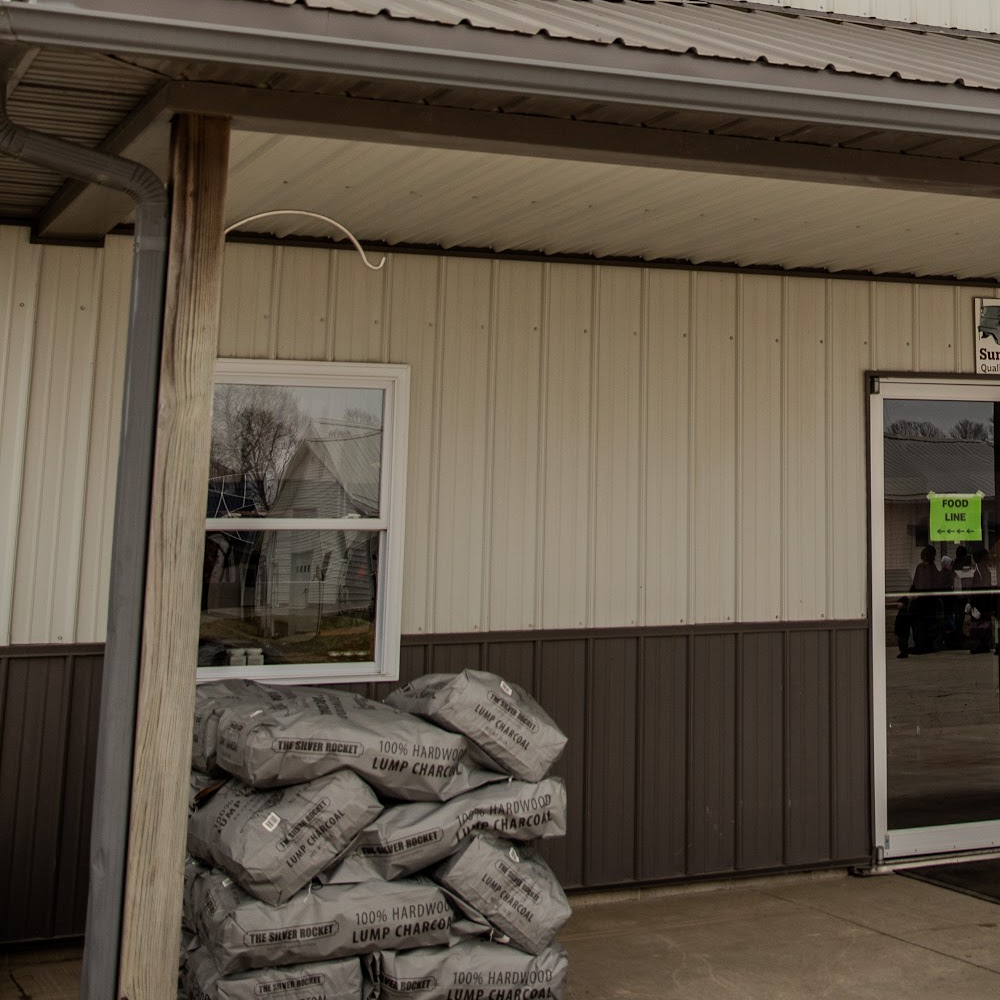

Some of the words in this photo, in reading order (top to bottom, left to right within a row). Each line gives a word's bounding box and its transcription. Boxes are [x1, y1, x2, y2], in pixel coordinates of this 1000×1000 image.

[942, 499, 969, 508] FOOD
[945, 513, 966, 521] LINE
[475, 704, 496, 722] LUMP
[495, 720, 530, 750] CHARCOAL
[278, 740, 294, 750] THE
[295, 740, 323, 752] SILVER
[325, 742, 359, 754] ROCKET
[379, 740, 408, 756] 100%
[412, 744, 465, 761] HARDWOO
[372, 757, 409, 772] LUMP
[489, 794, 552, 815] HARDWOOD
[494, 811, 552, 831] CHARCOAL
[286, 845, 306, 868] LUMP
[307, 810, 345, 845] CHARCOAL
[406, 831, 438, 848] ROCKET
[481, 873, 502, 893] LUMP
[500, 890, 534, 922] CHARCOAL
[355, 909, 388, 926] 100%
[392, 900, 450, 921] HARDWOO
[250, 933, 266, 944] THE
[269, 929, 297, 943] SILVER
[300, 924, 333, 938] ROCKET
[352, 927, 390, 944] LUMP
[395, 916, 452, 938] CHARCOA
[259, 984, 272, 994] THE
[272, 980, 295, 991] SILVER
[296, 976, 321, 988] ROCKET
[400, 979, 431, 991] ROCKET
[453, 971, 484, 985] 100%
[488, 969, 552, 985] HARDWOOD
[447, 989, 484, 1000] LUMP
[489, 987, 551, 1000] CHARCOAL
